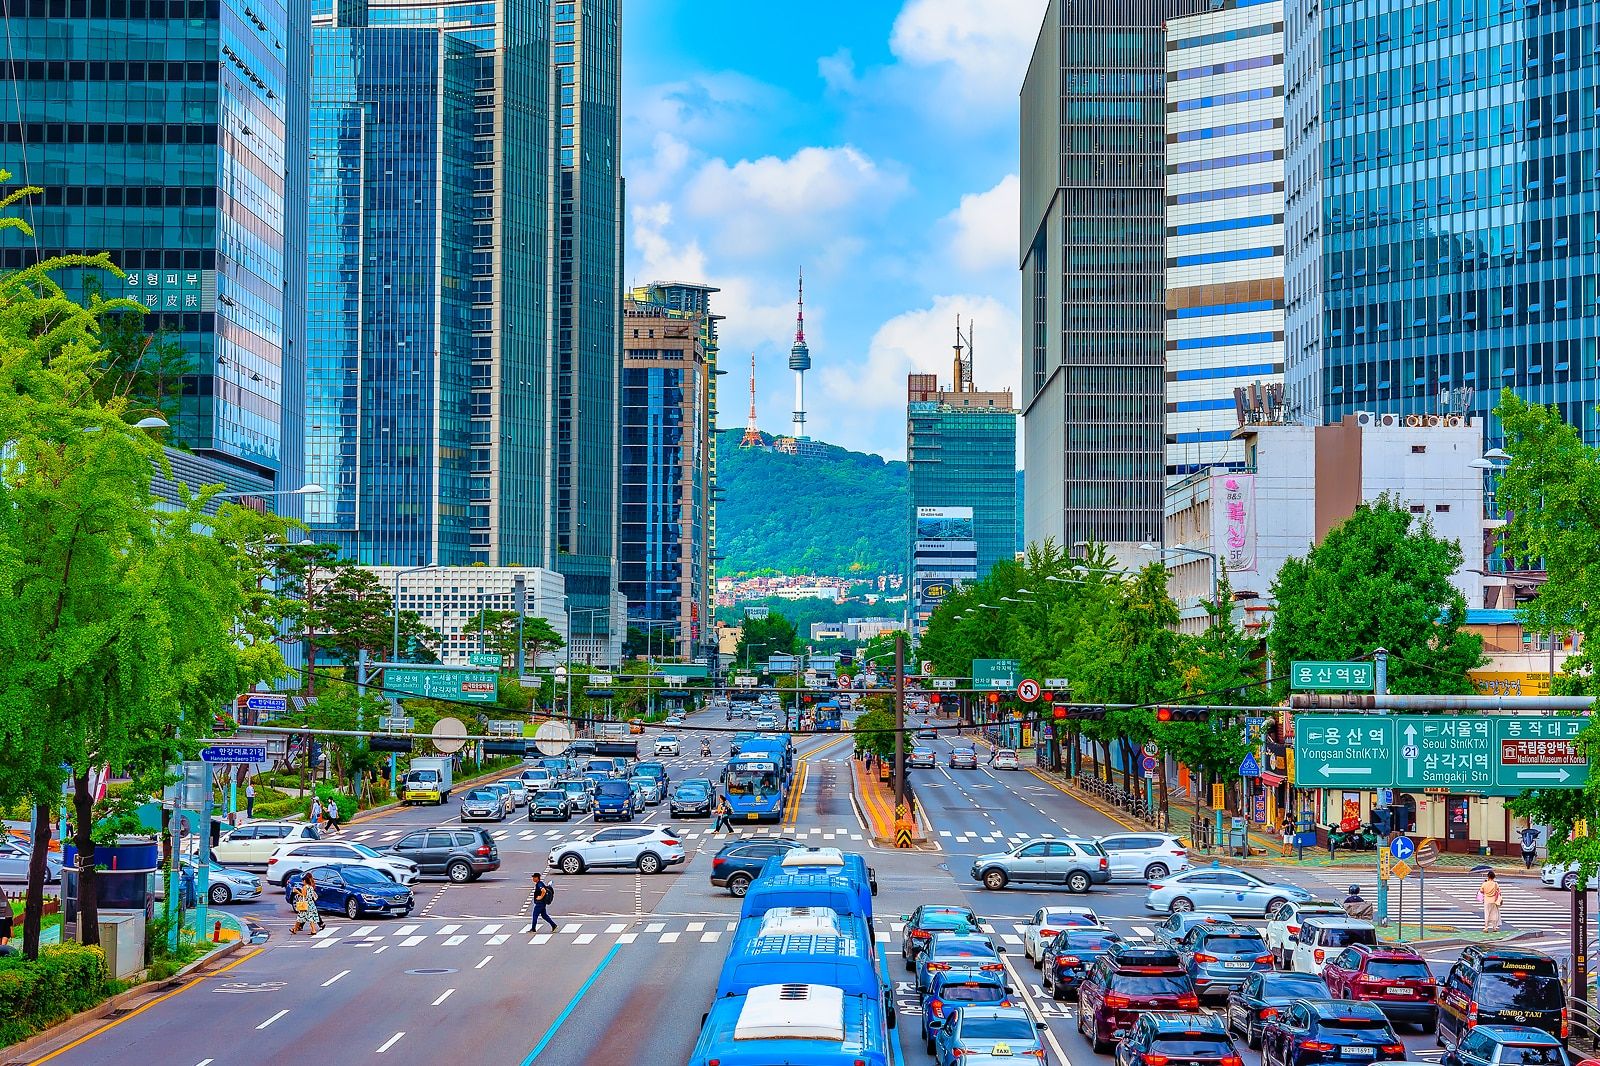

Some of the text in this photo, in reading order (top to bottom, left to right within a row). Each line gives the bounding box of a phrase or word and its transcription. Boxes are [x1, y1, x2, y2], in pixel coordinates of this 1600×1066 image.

[127, 273, 198, 286] 성형피부
[1226, 492, 1242, 501] B&S
[1230, 550, 1241, 560] 5F
[1298, 667, 1367, 684] 용산역앞
[1441, 721, 1488, 737] 서울역
[1508, 721, 1579, 736] 동작대교
[1325, 727, 1384, 745] 용산역
[1422, 738, 1488, 749] Seoul Stn(KTX)
[1518, 741, 1585, 755] 국립중앙박물
[219, 748, 264, 756] 한강대로21길
[1302, 748, 1389, 761] Yongsan Stn(KTX)
[1405, 747, 1417, 757] 21
[1424, 753, 1488, 769] 삼각지역
[1517, 755, 1585, 763] National Museum of Korea
[1422, 770, 1488, 783] Samgakji Stn
[1502, 962, 1536, 970] Limousine
[1498, 1009, 1523, 1017] JUMBO
